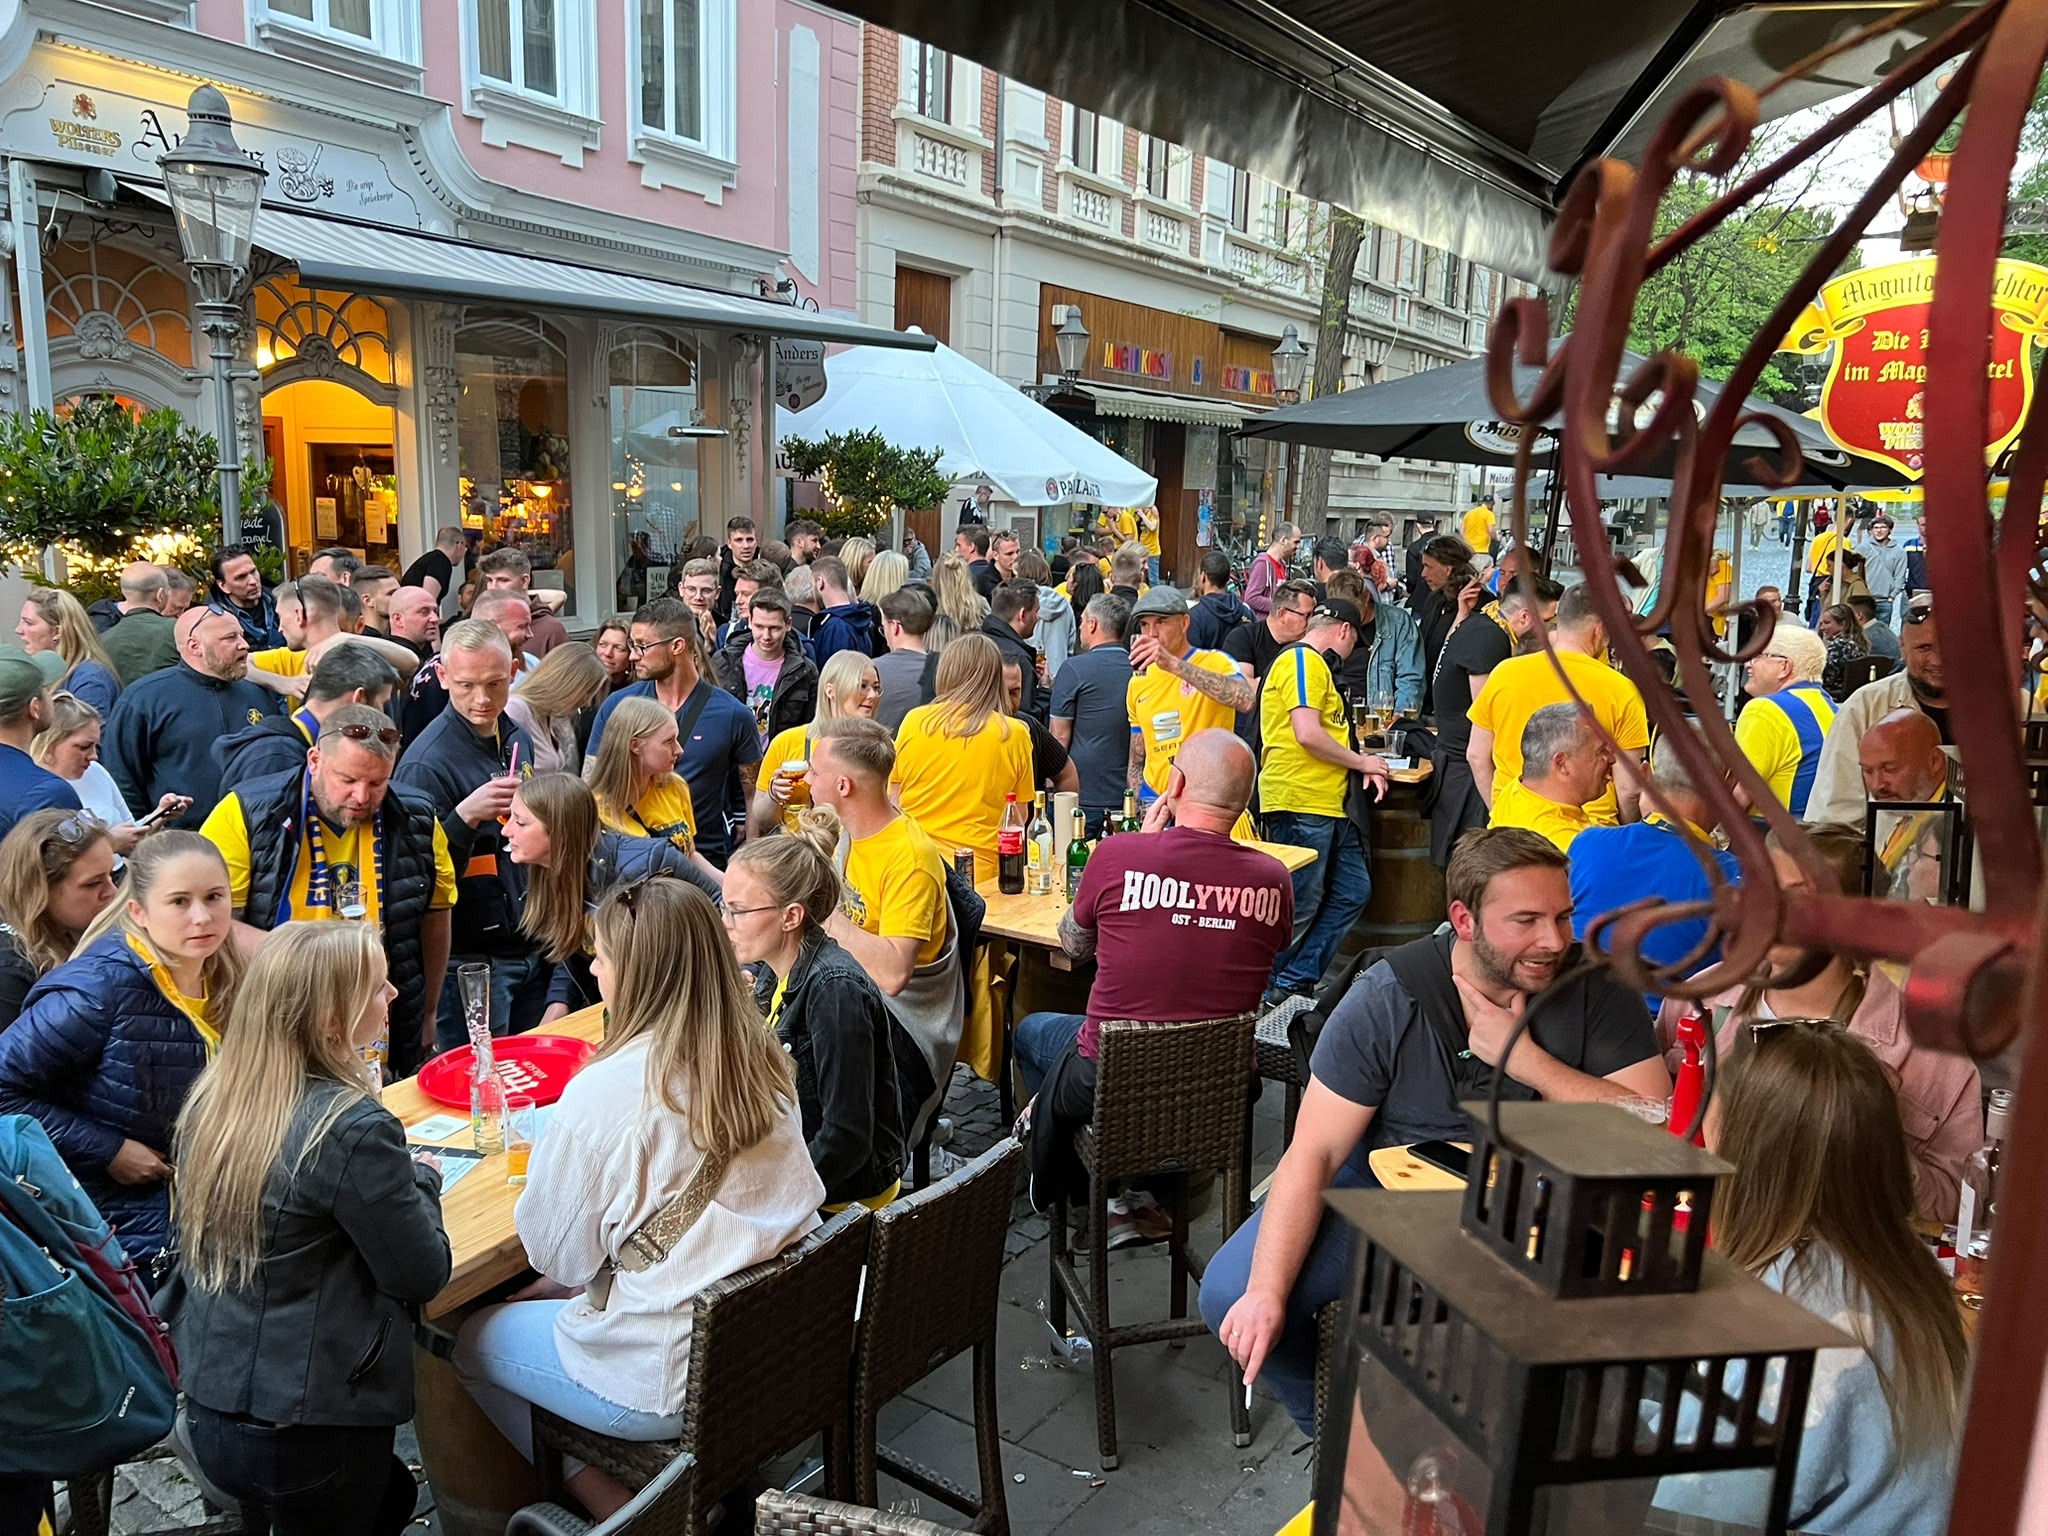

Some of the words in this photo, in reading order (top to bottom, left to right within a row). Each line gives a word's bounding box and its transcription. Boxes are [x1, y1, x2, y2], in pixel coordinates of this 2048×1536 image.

[49, 119, 122, 148] WOLTERS
[58, 136, 116, 157] Pilsener
[1872, 331, 1909, 351] Die
[1104, 341, 1140, 374] MAGNI
[1141, 349, 1171, 381] KIOSK
[1844, 362, 1870, 381] im
[1119, 870, 1282, 927] HOOLYWOOD
[1171, 913, 1190, 926] OST
[1199, 916, 1236, 930] BERLIN
